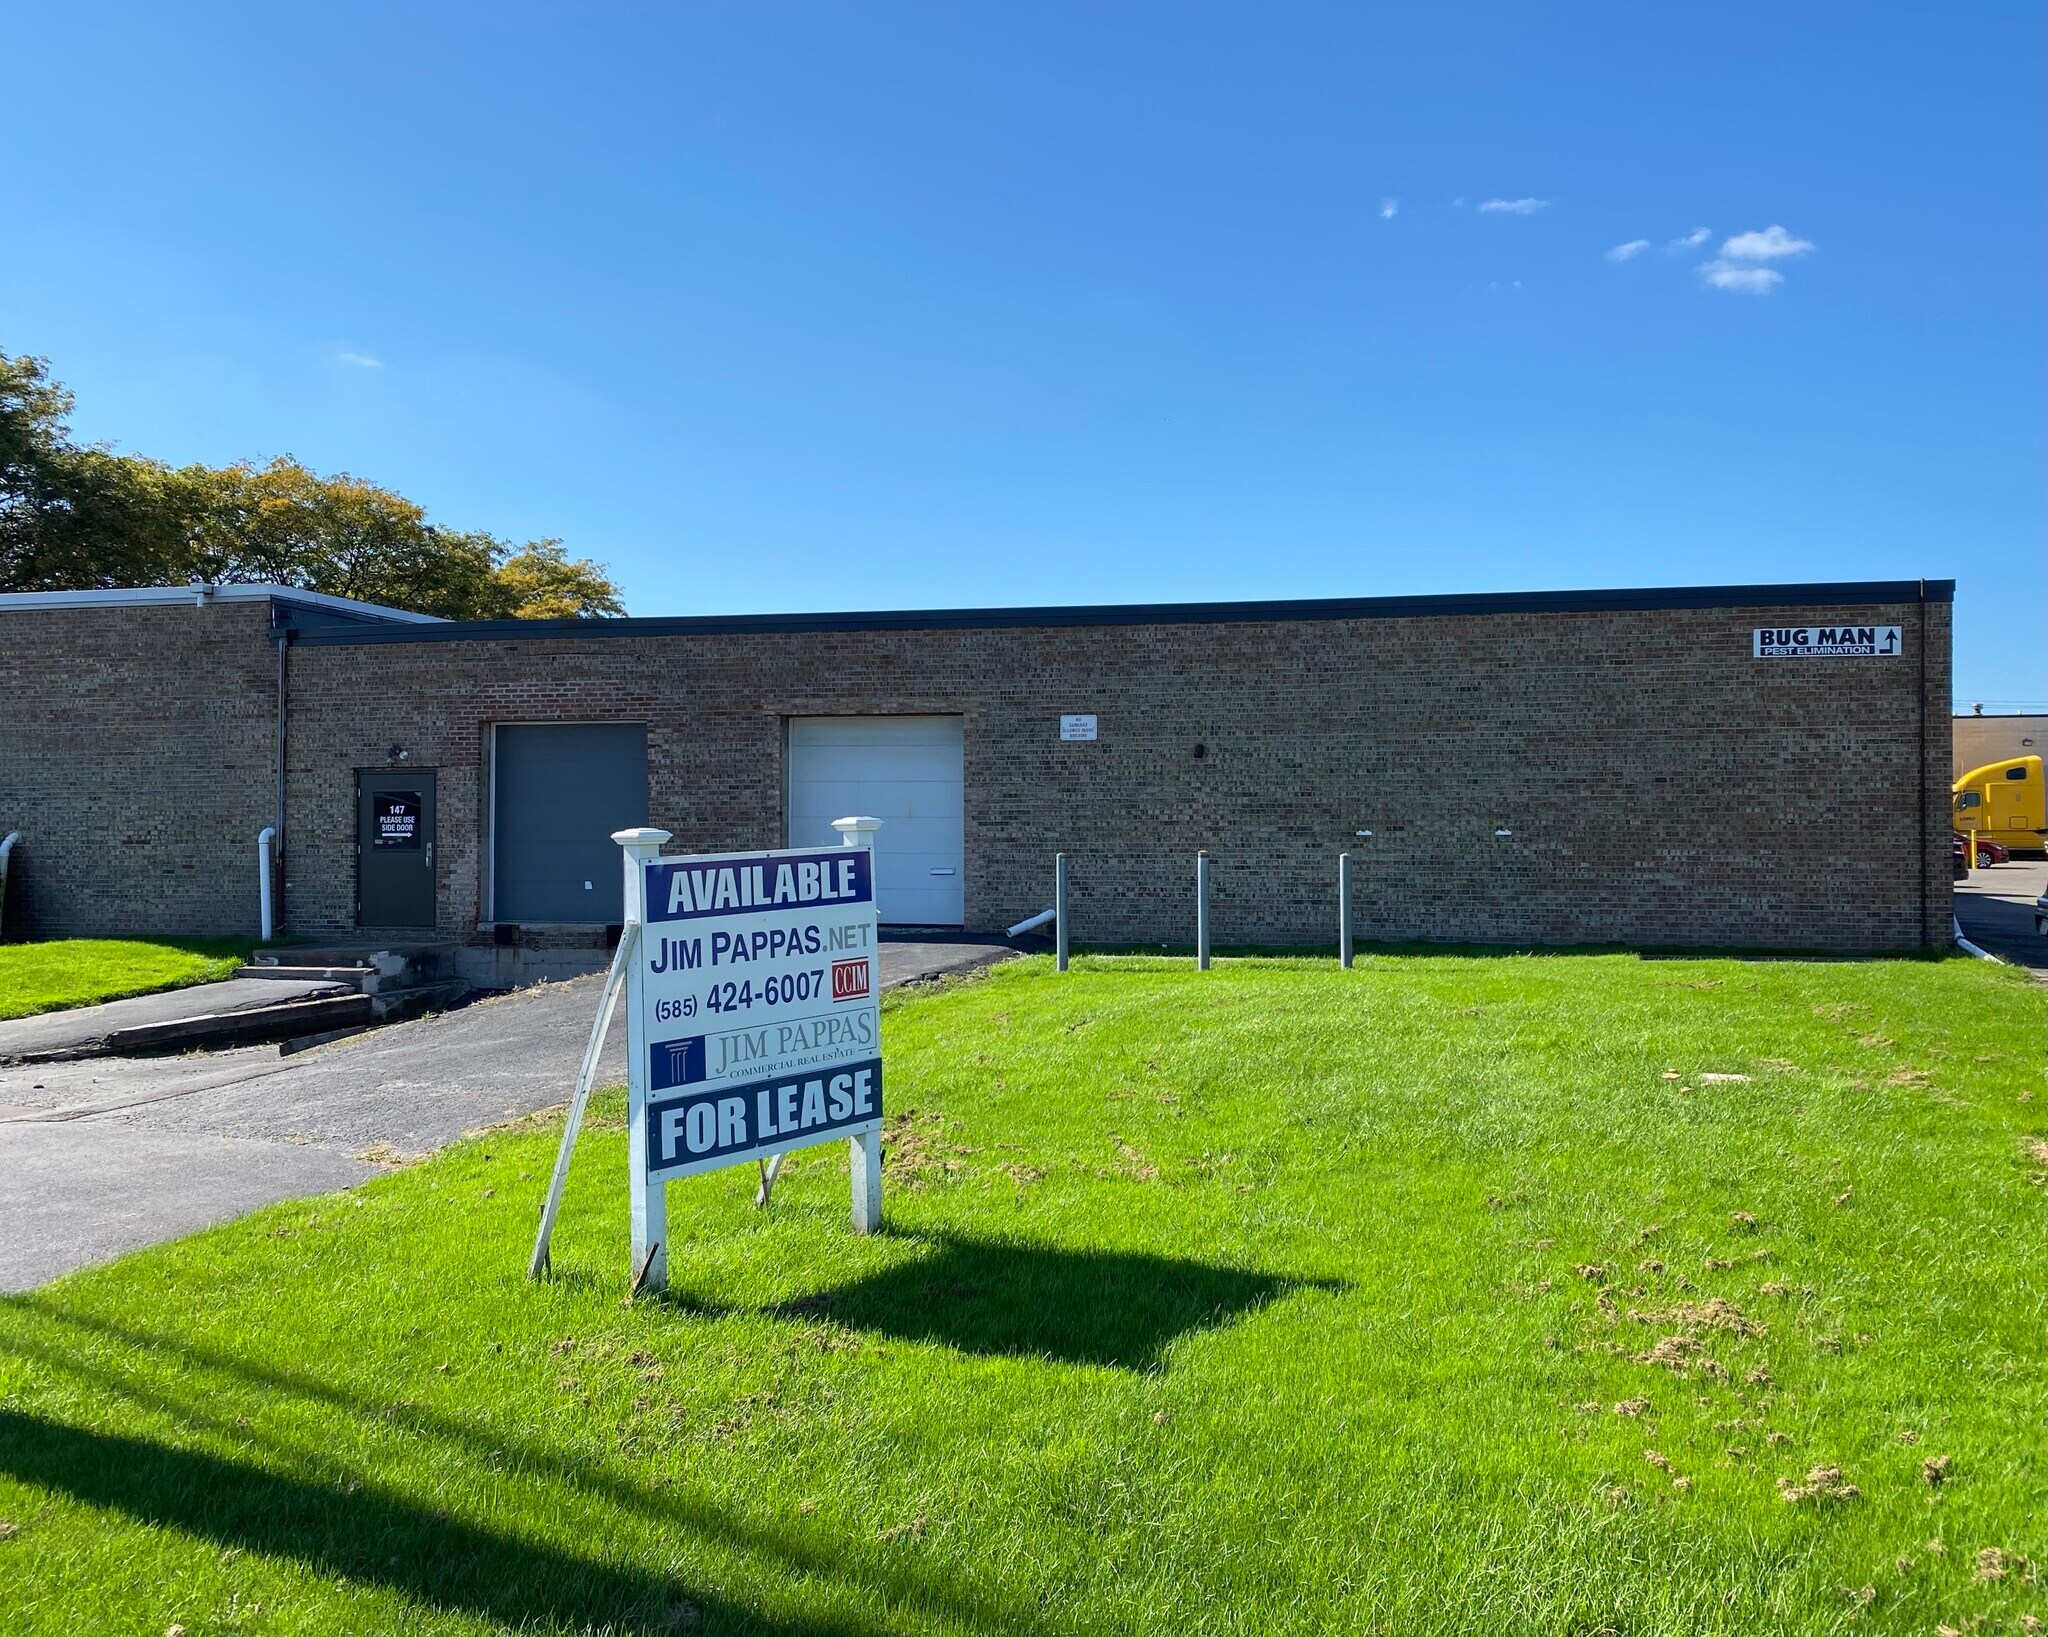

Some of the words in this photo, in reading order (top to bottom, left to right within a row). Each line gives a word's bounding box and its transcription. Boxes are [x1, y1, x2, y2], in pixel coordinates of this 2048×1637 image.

[1760, 629, 1808, 646] BUG
[1818, 628, 1875, 644] MAN
[1798, 646, 1870, 654] ELIMINATION
[390, 806, 405, 814] 147
[667, 859, 856, 914] AVAILABLE
[834, 965, 868, 995] CCIM
[655, 994, 698, 1023] (585)
[706, 969, 825, 1014] 424-6007
[716, 1030, 768, 1074] JIM
[777, 1012, 872, 1055] PAPPAS
[730, 1061, 797, 1079] COMMERCIAL
[797, 1055, 822, 1066] REAL
[822, 1048, 856, 1061] ESTATE
[661, 1096, 747, 1160] FOR
[756, 1068, 873, 1139] LEASE
